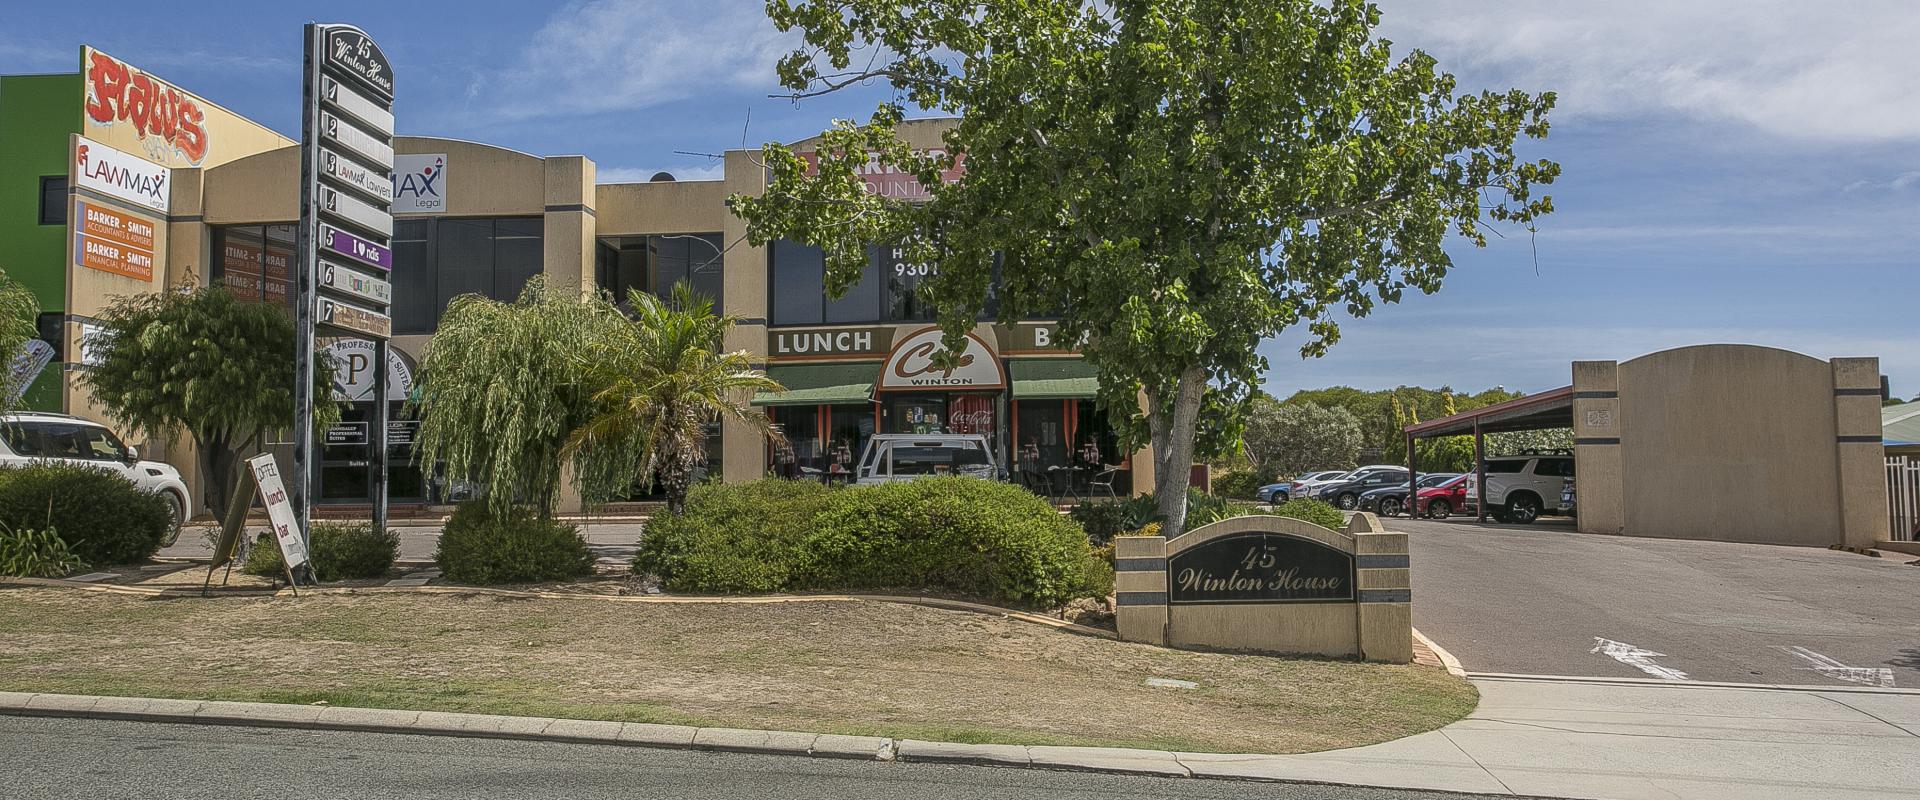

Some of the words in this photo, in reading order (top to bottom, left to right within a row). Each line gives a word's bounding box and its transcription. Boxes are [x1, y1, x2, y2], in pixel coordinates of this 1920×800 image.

[356, 36, 372, 59] 45
[336, 37, 366, 74] Winton
[367, 60, 392, 90] House
[328, 84, 337, 99] 1
[328, 118, 337, 136] 2
[327, 156, 336, 173] 3
[366, 177, 391, 198] Lawyers
[150, 198, 165, 209] Legal
[327, 192, 336, 209] 4
[415, 199, 441, 209] Legal
[87, 208, 120, 229] BARKER
[127, 221, 152, 238] SMITH
[87, 222, 126, 239] ACCOUNTANTS
[130, 234, 152, 247] ADVISERS
[326, 230, 336, 246] 5
[86, 241, 120, 260] BARKER
[126, 252, 151, 268] SMITH
[352, 239, 358, 254] I
[366, 247, 380, 262] ndis
[86, 253, 120, 270] FINANCIAL
[120, 262, 151, 277] PLANNING
[325, 266, 334, 283] 6
[324, 303, 334, 321] 7
[778, 331, 872, 353] LUNCH
[1035, 327, 1090, 347] BR
[345, 353, 369, 386] P
[911, 378, 973, 386] WINTON
[255, 462, 278, 482] COFFEE
[265, 487, 286, 506] lunch
[276, 524, 290, 538] bar
[1240, 545, 1279, 571] 45
[1177, 567, 1265, 592] Winton
[1268, 567, 1344, 592] House
